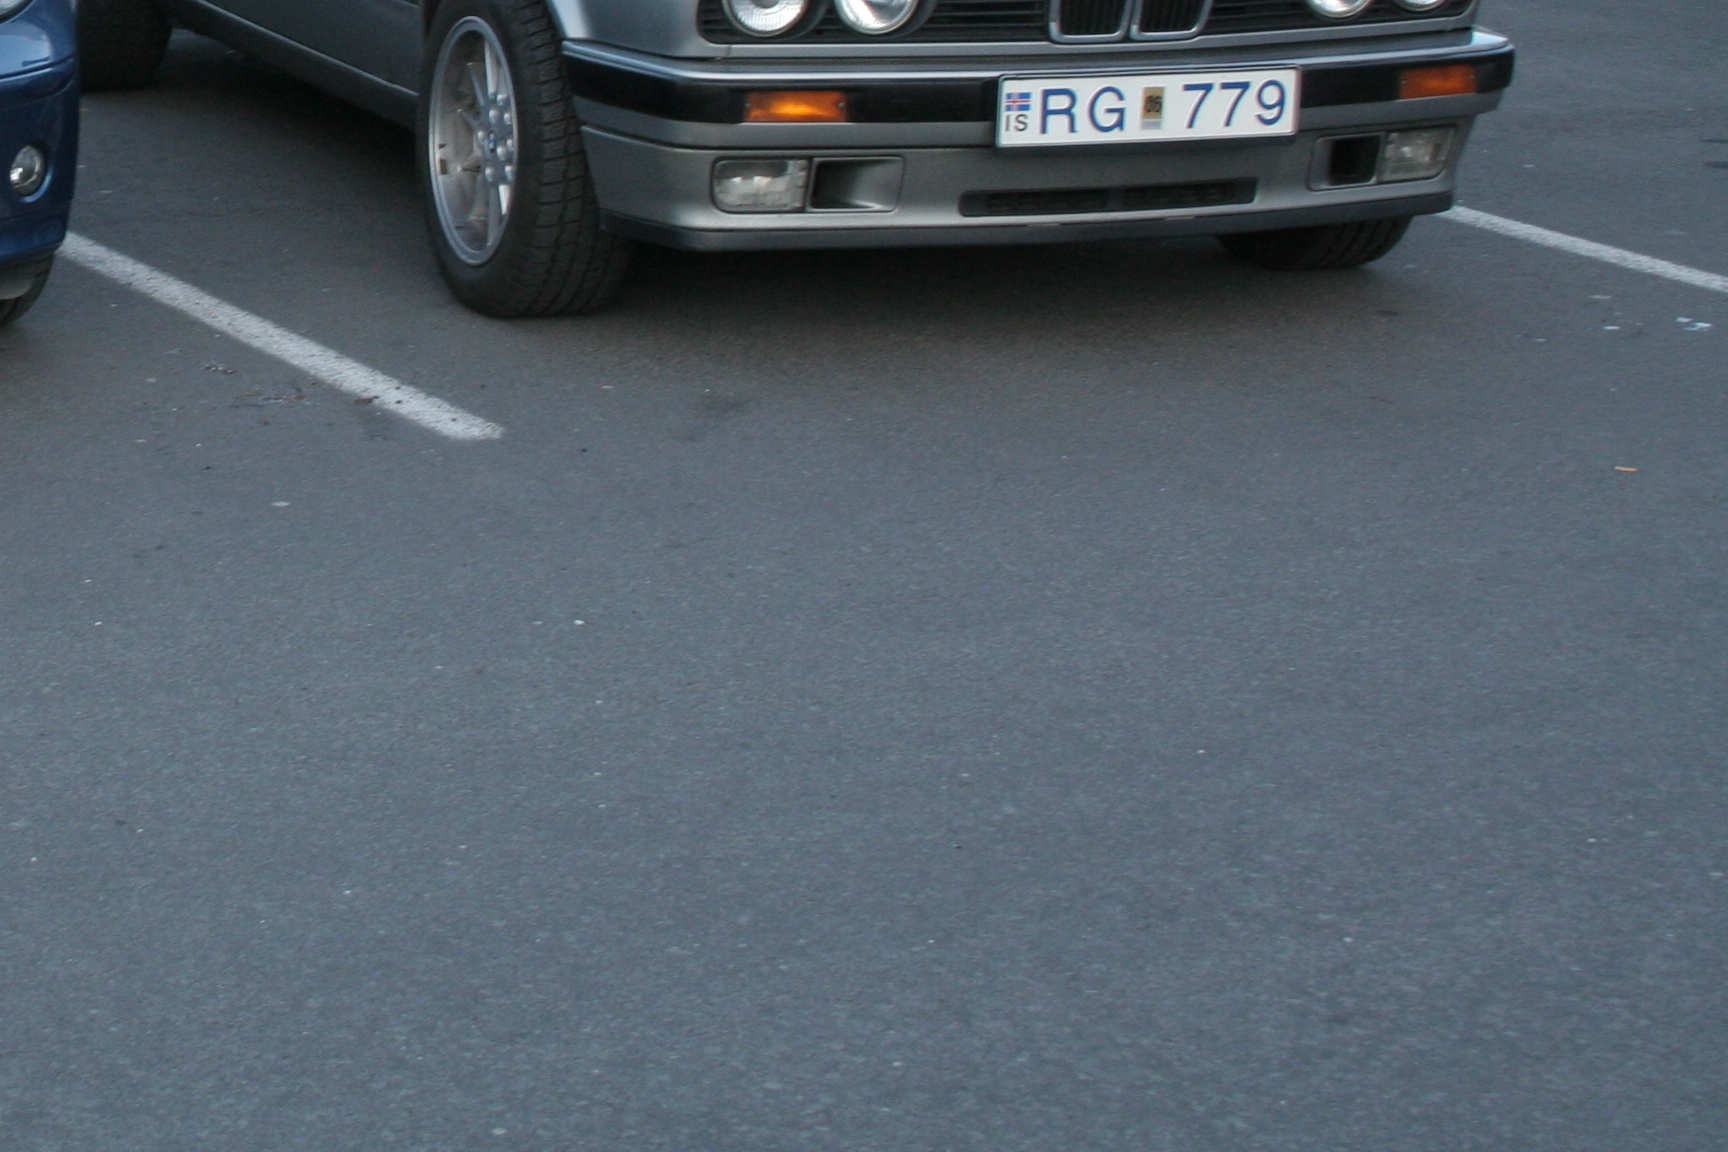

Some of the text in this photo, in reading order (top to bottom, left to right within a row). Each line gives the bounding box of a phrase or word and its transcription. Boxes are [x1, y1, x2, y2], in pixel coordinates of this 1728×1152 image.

[1004, 113, 1029, 133] IS
[1038, 78, 1286, 135] RG 779
